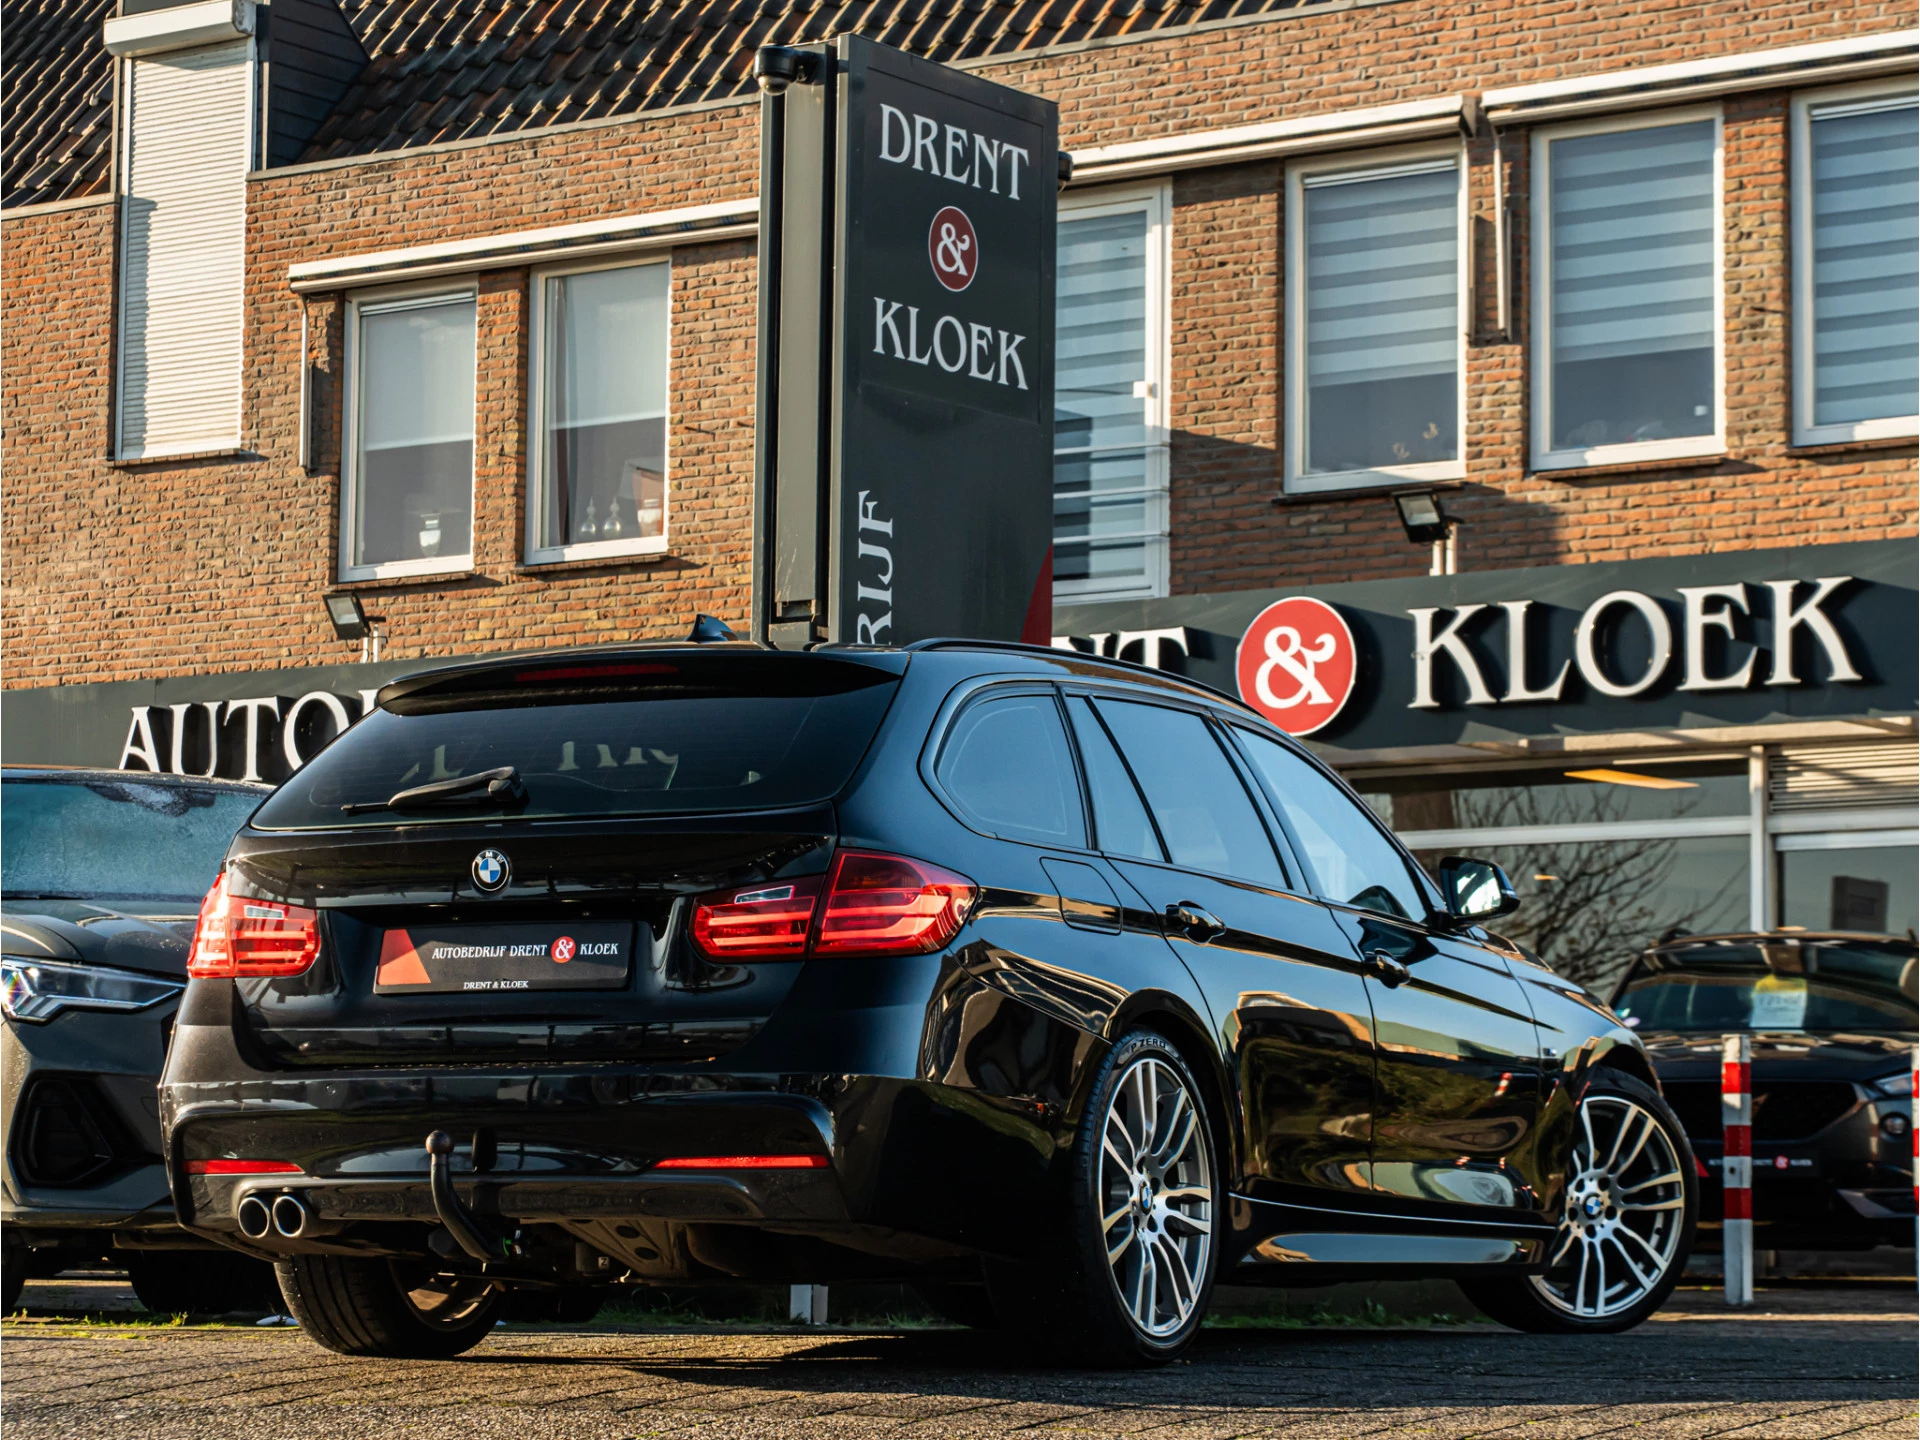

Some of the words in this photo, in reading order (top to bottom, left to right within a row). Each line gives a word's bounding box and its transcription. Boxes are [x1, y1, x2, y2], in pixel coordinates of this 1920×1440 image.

[879, 103, 1030, 200] DRENT
[936, 222, 970, 277] &
[873, 297, 1029, 390] KLOEK
[118, 689, 379, 782] AUTO
[1254, 626, 1337, 709] &
[1407, 576, 1863, 709] KLOEK
[432, 945, 506, 960] AUTOBEDRIJF
[509, 944, 547, 956] DRENT
[554, 938, 573, 959] &
[579, 943, 619, 955] KLOEK
[463, 981, 491, 989] DRENT
[500, 980, 529, 988] KLOEK
[1139, 1038, 1166, 1049] ZERO
